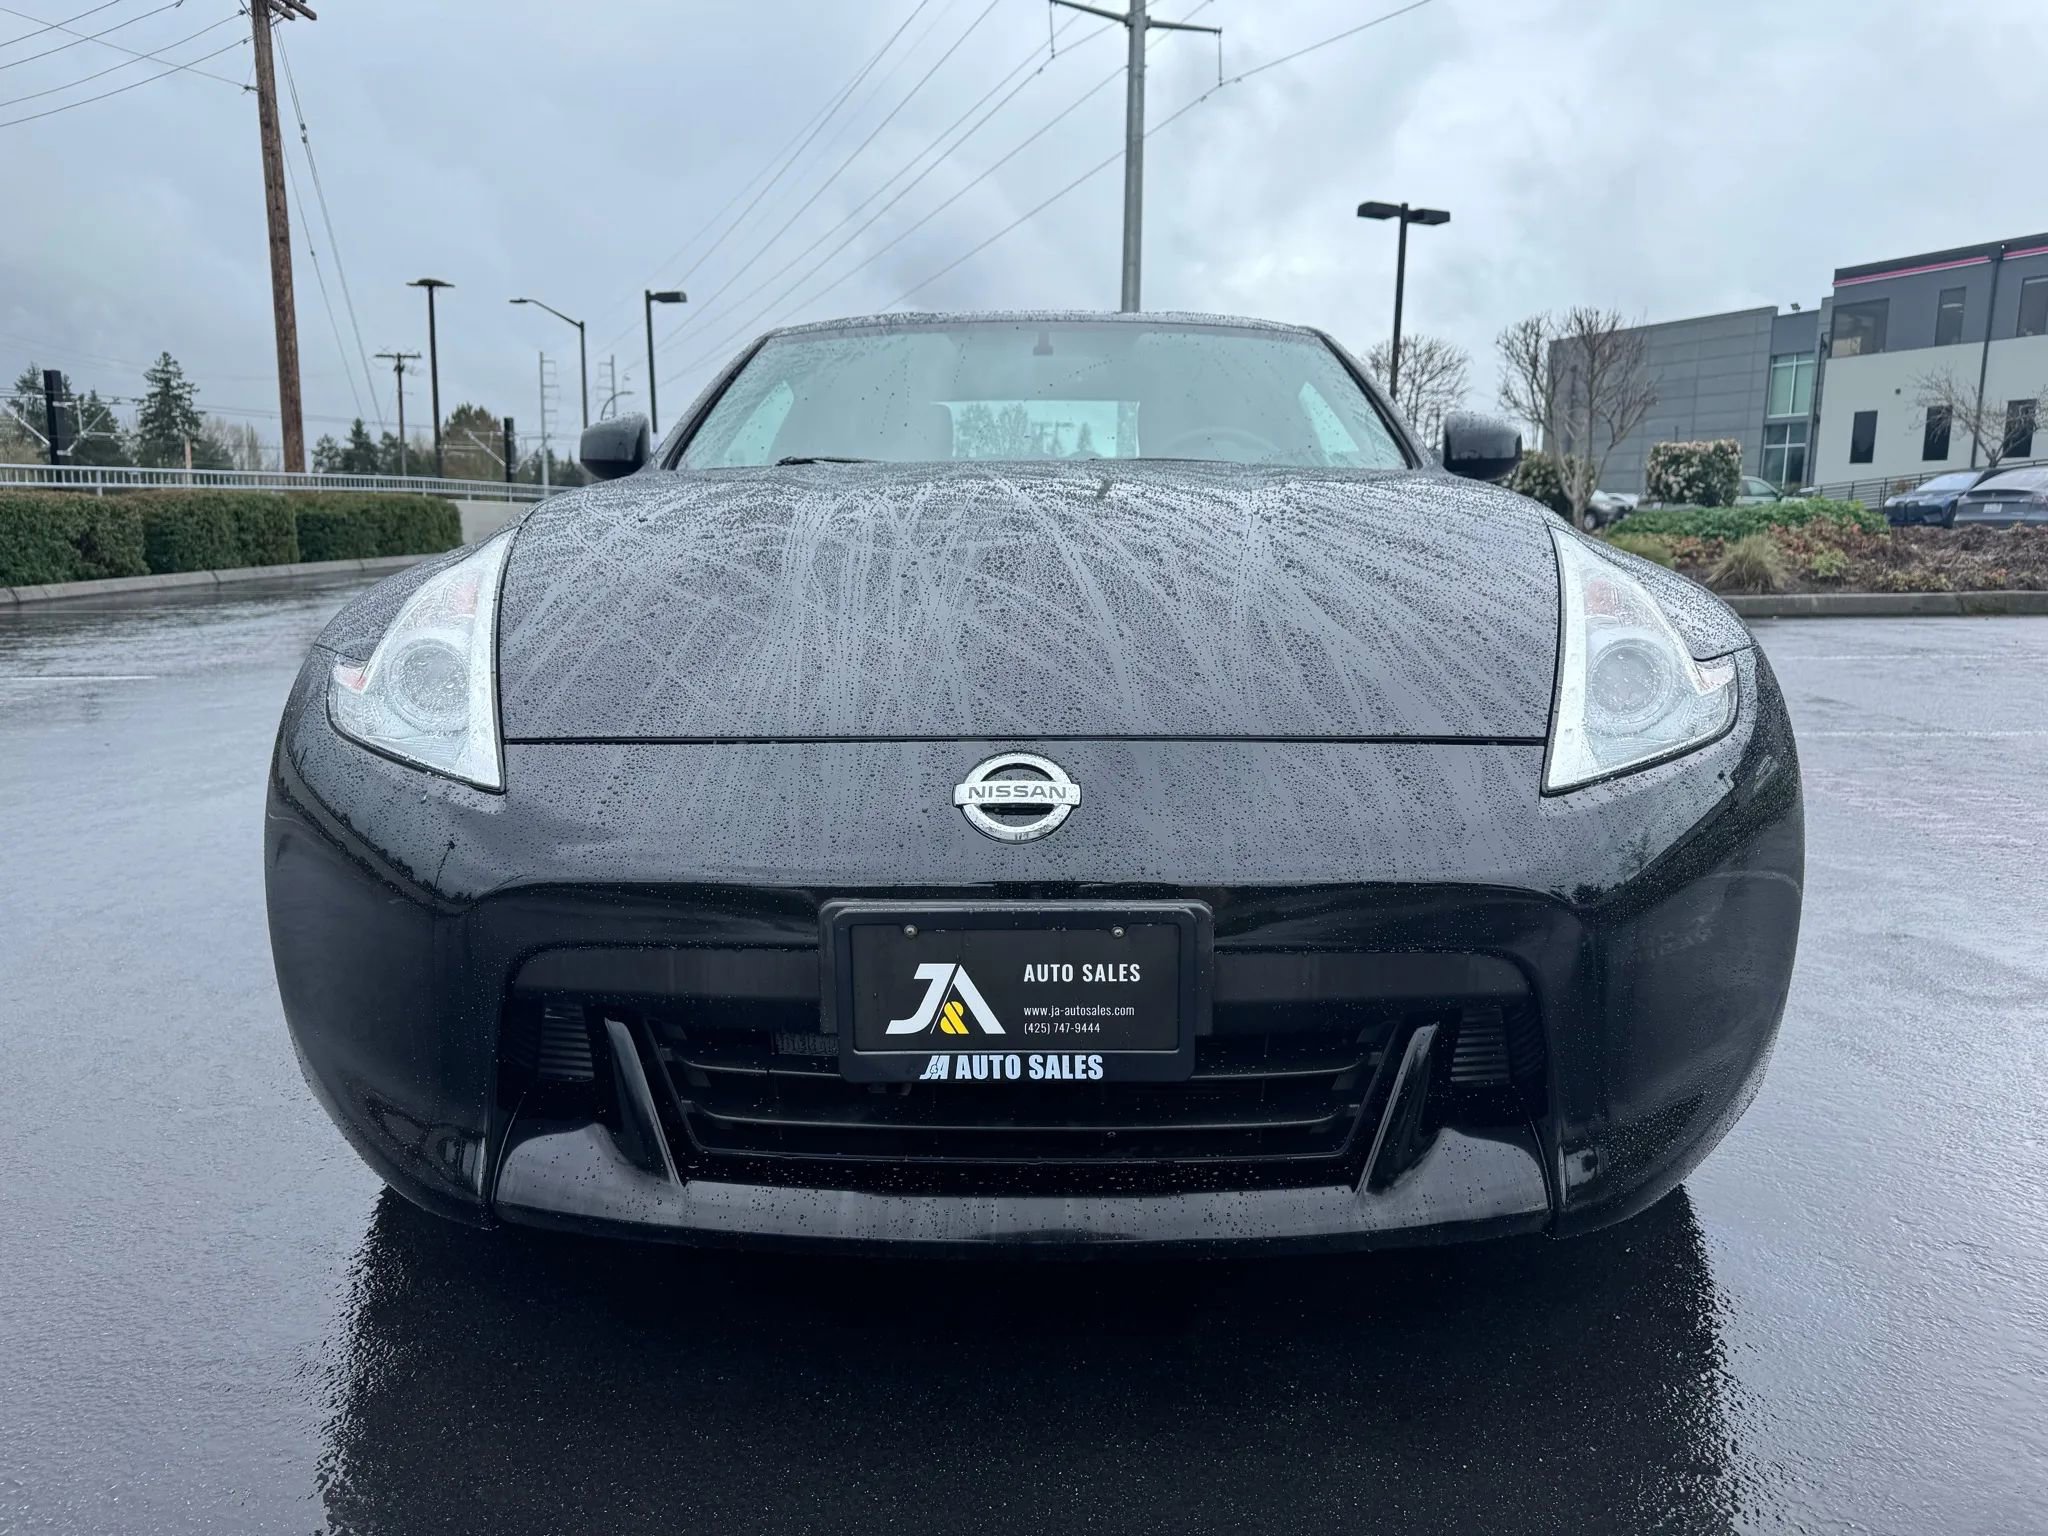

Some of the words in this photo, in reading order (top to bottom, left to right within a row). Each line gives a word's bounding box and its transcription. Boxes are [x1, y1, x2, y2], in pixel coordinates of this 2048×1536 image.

[968, 785, 1066, 799] NISSAN
[1023, 963, 1074, 982] AUTO
[1082, 963, 1141, 982] SALES
[1023, 1005, 1135, 1017] www.ja-autosales.com
[1024, 1022, 1051, 1035] (425)
[1053, 1022, 1101, 1033] 747-9444
[955, 1054, 1021, 1080] AUTO
[1028, 1054, 1104, 1080] SALES
